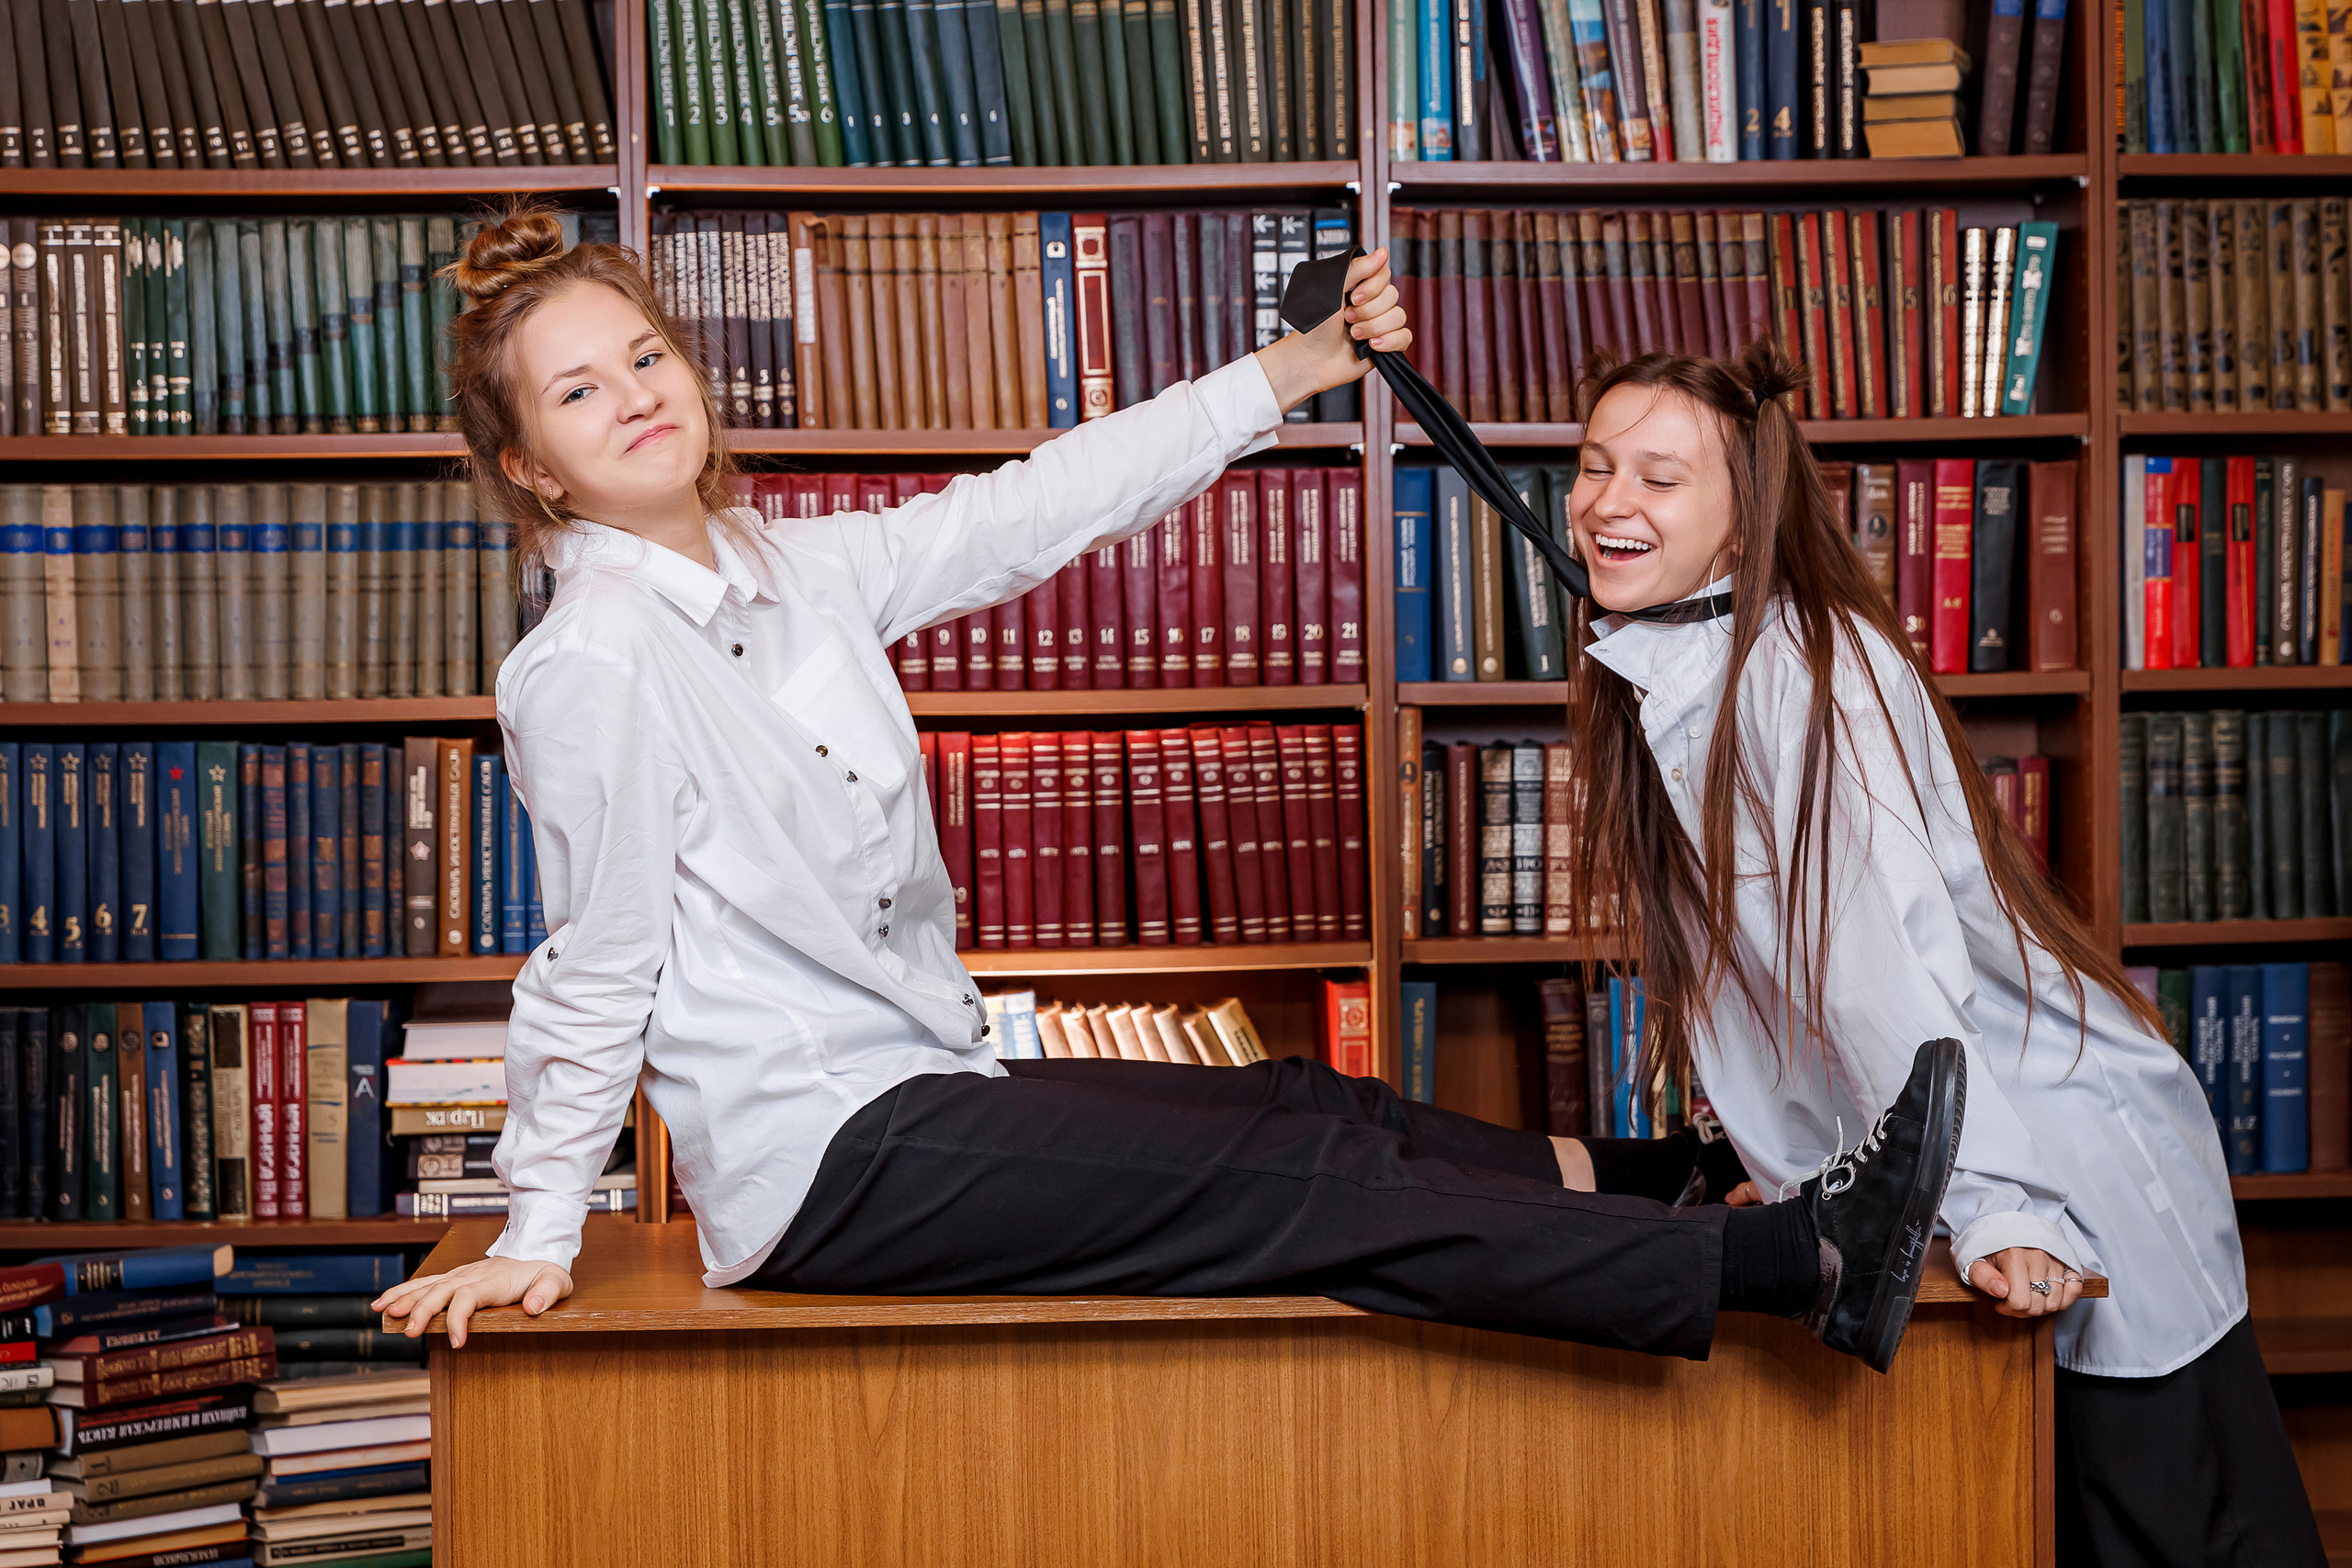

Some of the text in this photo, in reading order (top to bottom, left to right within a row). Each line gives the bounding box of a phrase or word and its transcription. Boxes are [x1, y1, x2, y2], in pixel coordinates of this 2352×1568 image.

[1746, 107, 1760, 132] 2
[1773, 106, 1791, 130] 4
[1810, 286, 1825, 310] 2
[1838, 285, 1851, 308] 3
[1905, 287, 1917, 310] 5
[1943, 283, 1956, 307] 6
[759, 368, 769, 384] 5
[780, 367, 791, 382] 6
[907, 631, 918, 648] 8
[938, 628, 950, 645] 9
[971, 627, 987, 644] 10
[1037, 629, 1054, 646] 12
[1201, 626, 1216, 643] 17
[1235, 625, 1250, 642] 18
[1305, 623, 1323, 640] 20
[1341, 622, 1358, 639] 21
[449, 748, 461, 781] СЛОВ
[481, 761, 492, 795] СЛОВ
[449, 867, 461, 919] СЛОВАРЬ
[30, 905, 48, 930] 4
[95, 903, 112, 928] 6
[131, 904, 148, 929] 7
[481, 882, 492, 932] СЛОВАРЬ
[65, 916, 81, 942] 5
[77, 1426, 117, 1444] ВЛАСТЬ
[9, 1497, 46, 1512] ВРАГ
